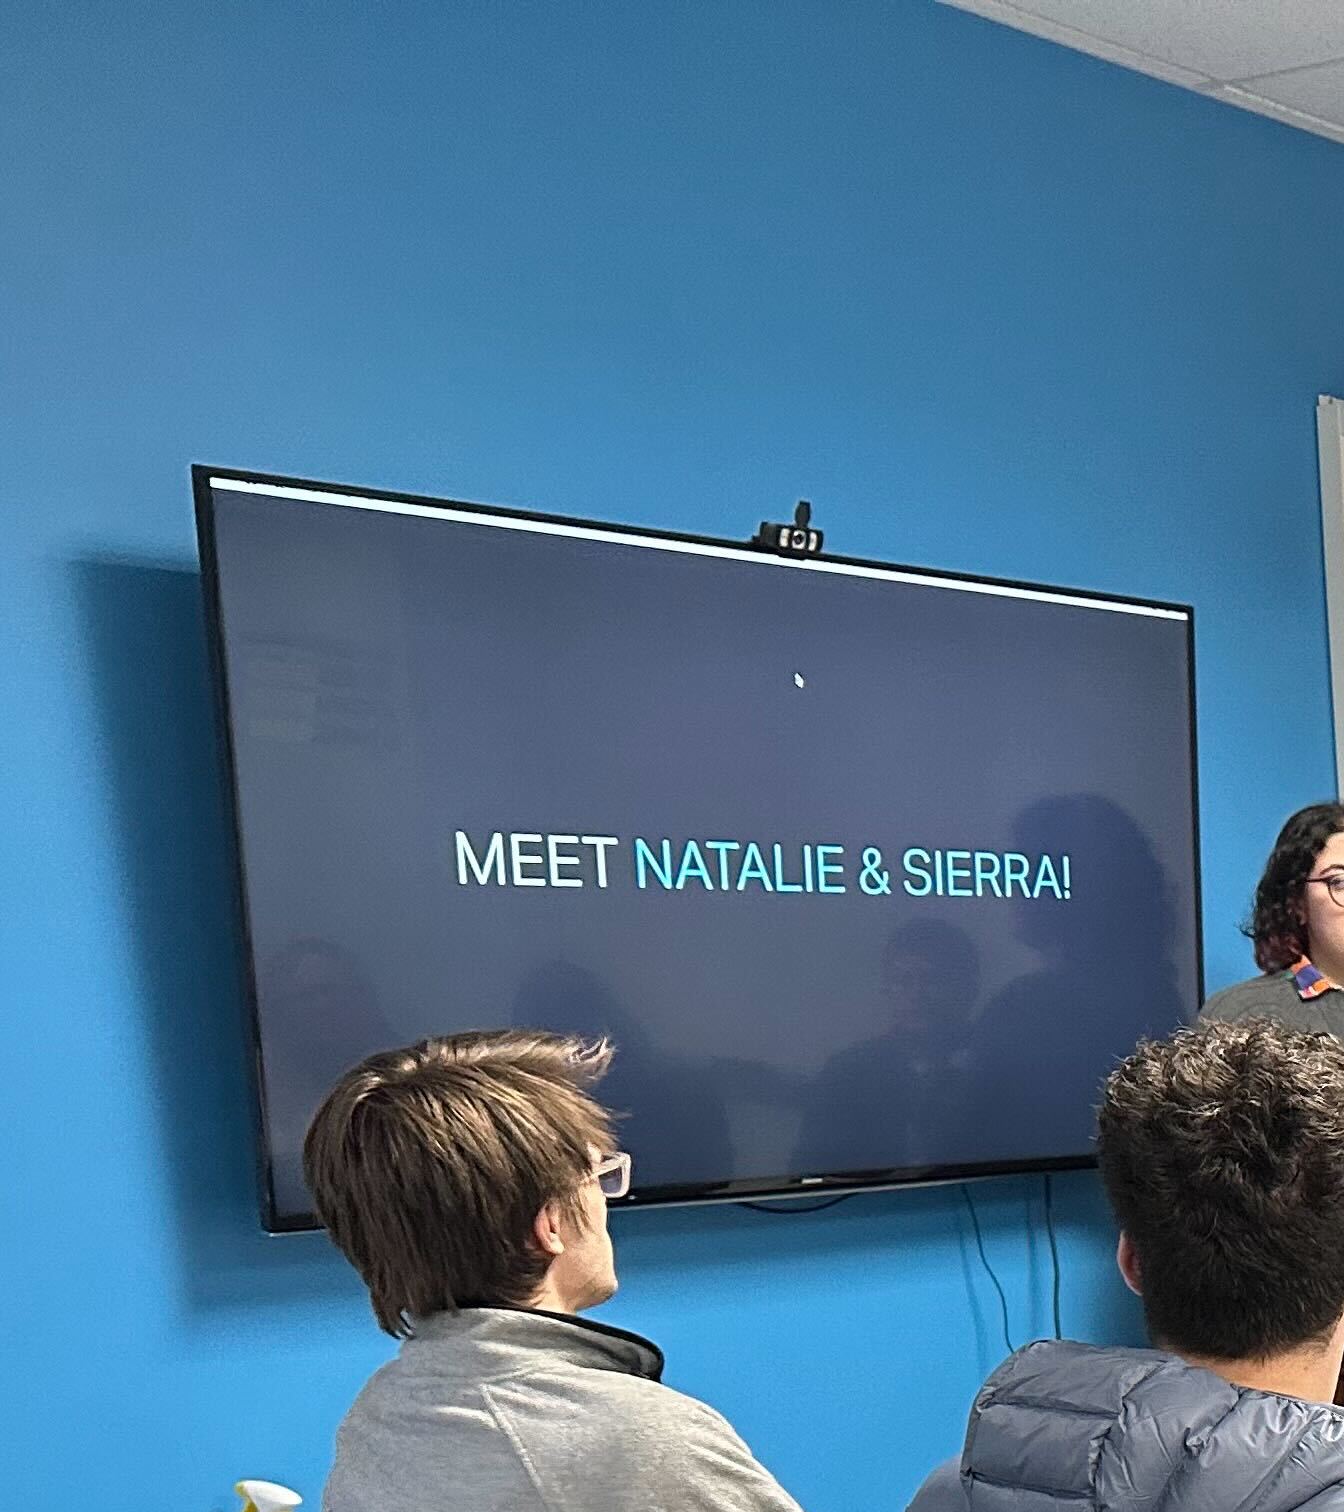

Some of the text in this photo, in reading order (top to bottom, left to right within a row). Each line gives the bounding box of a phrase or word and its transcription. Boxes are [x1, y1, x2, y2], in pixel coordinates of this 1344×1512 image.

[455, 830, 1072, 900] MEET NATALIE & SIERRA!
